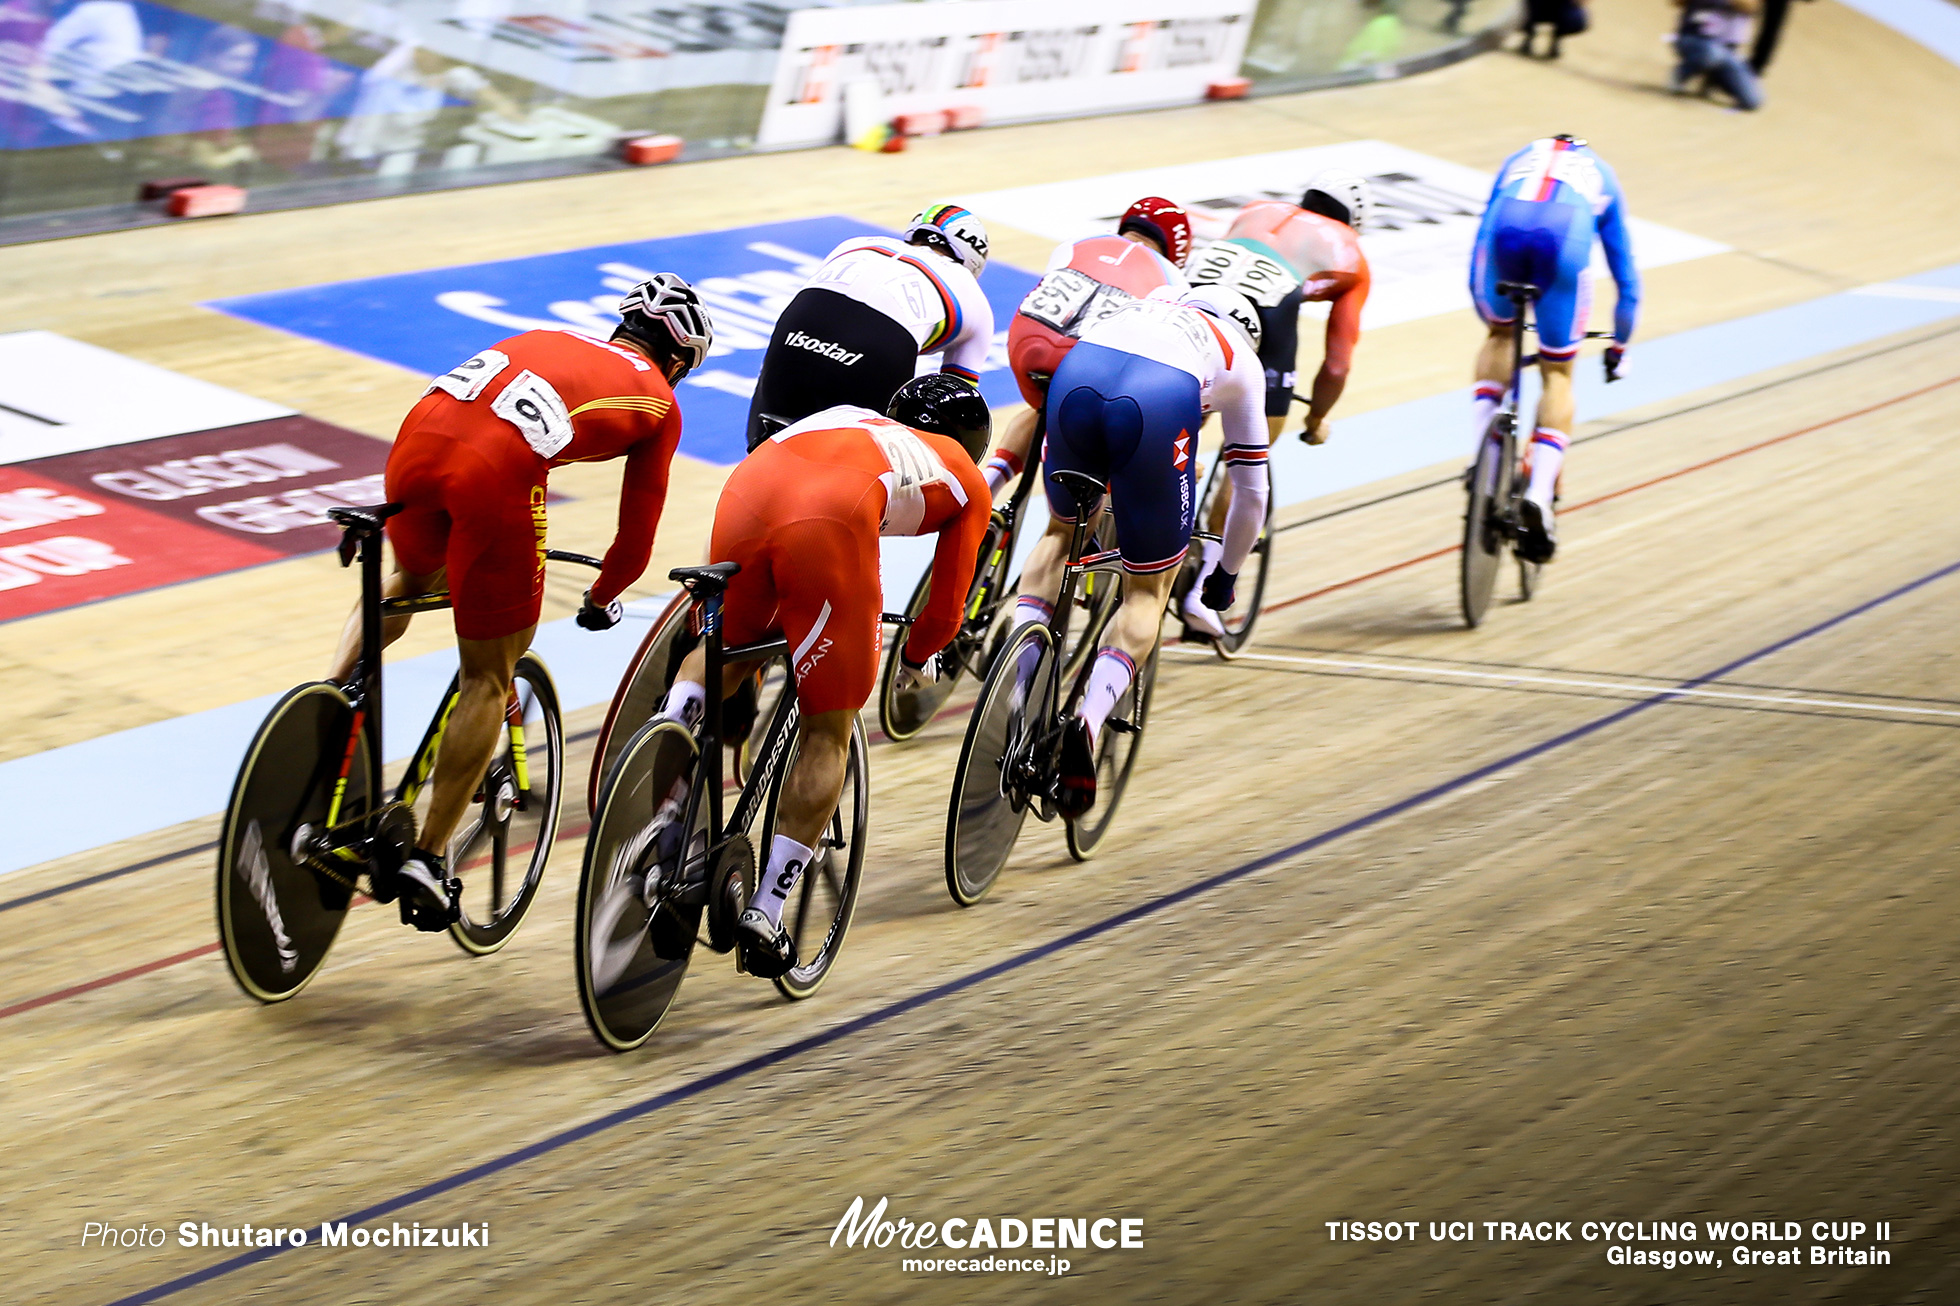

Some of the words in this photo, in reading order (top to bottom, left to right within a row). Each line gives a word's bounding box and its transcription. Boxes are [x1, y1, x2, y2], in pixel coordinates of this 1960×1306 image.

[1031, 274, 1083, 316] 263
[1179, 473, 1190, 511] HSBC
[530, 485, 548, 572] CHINA
